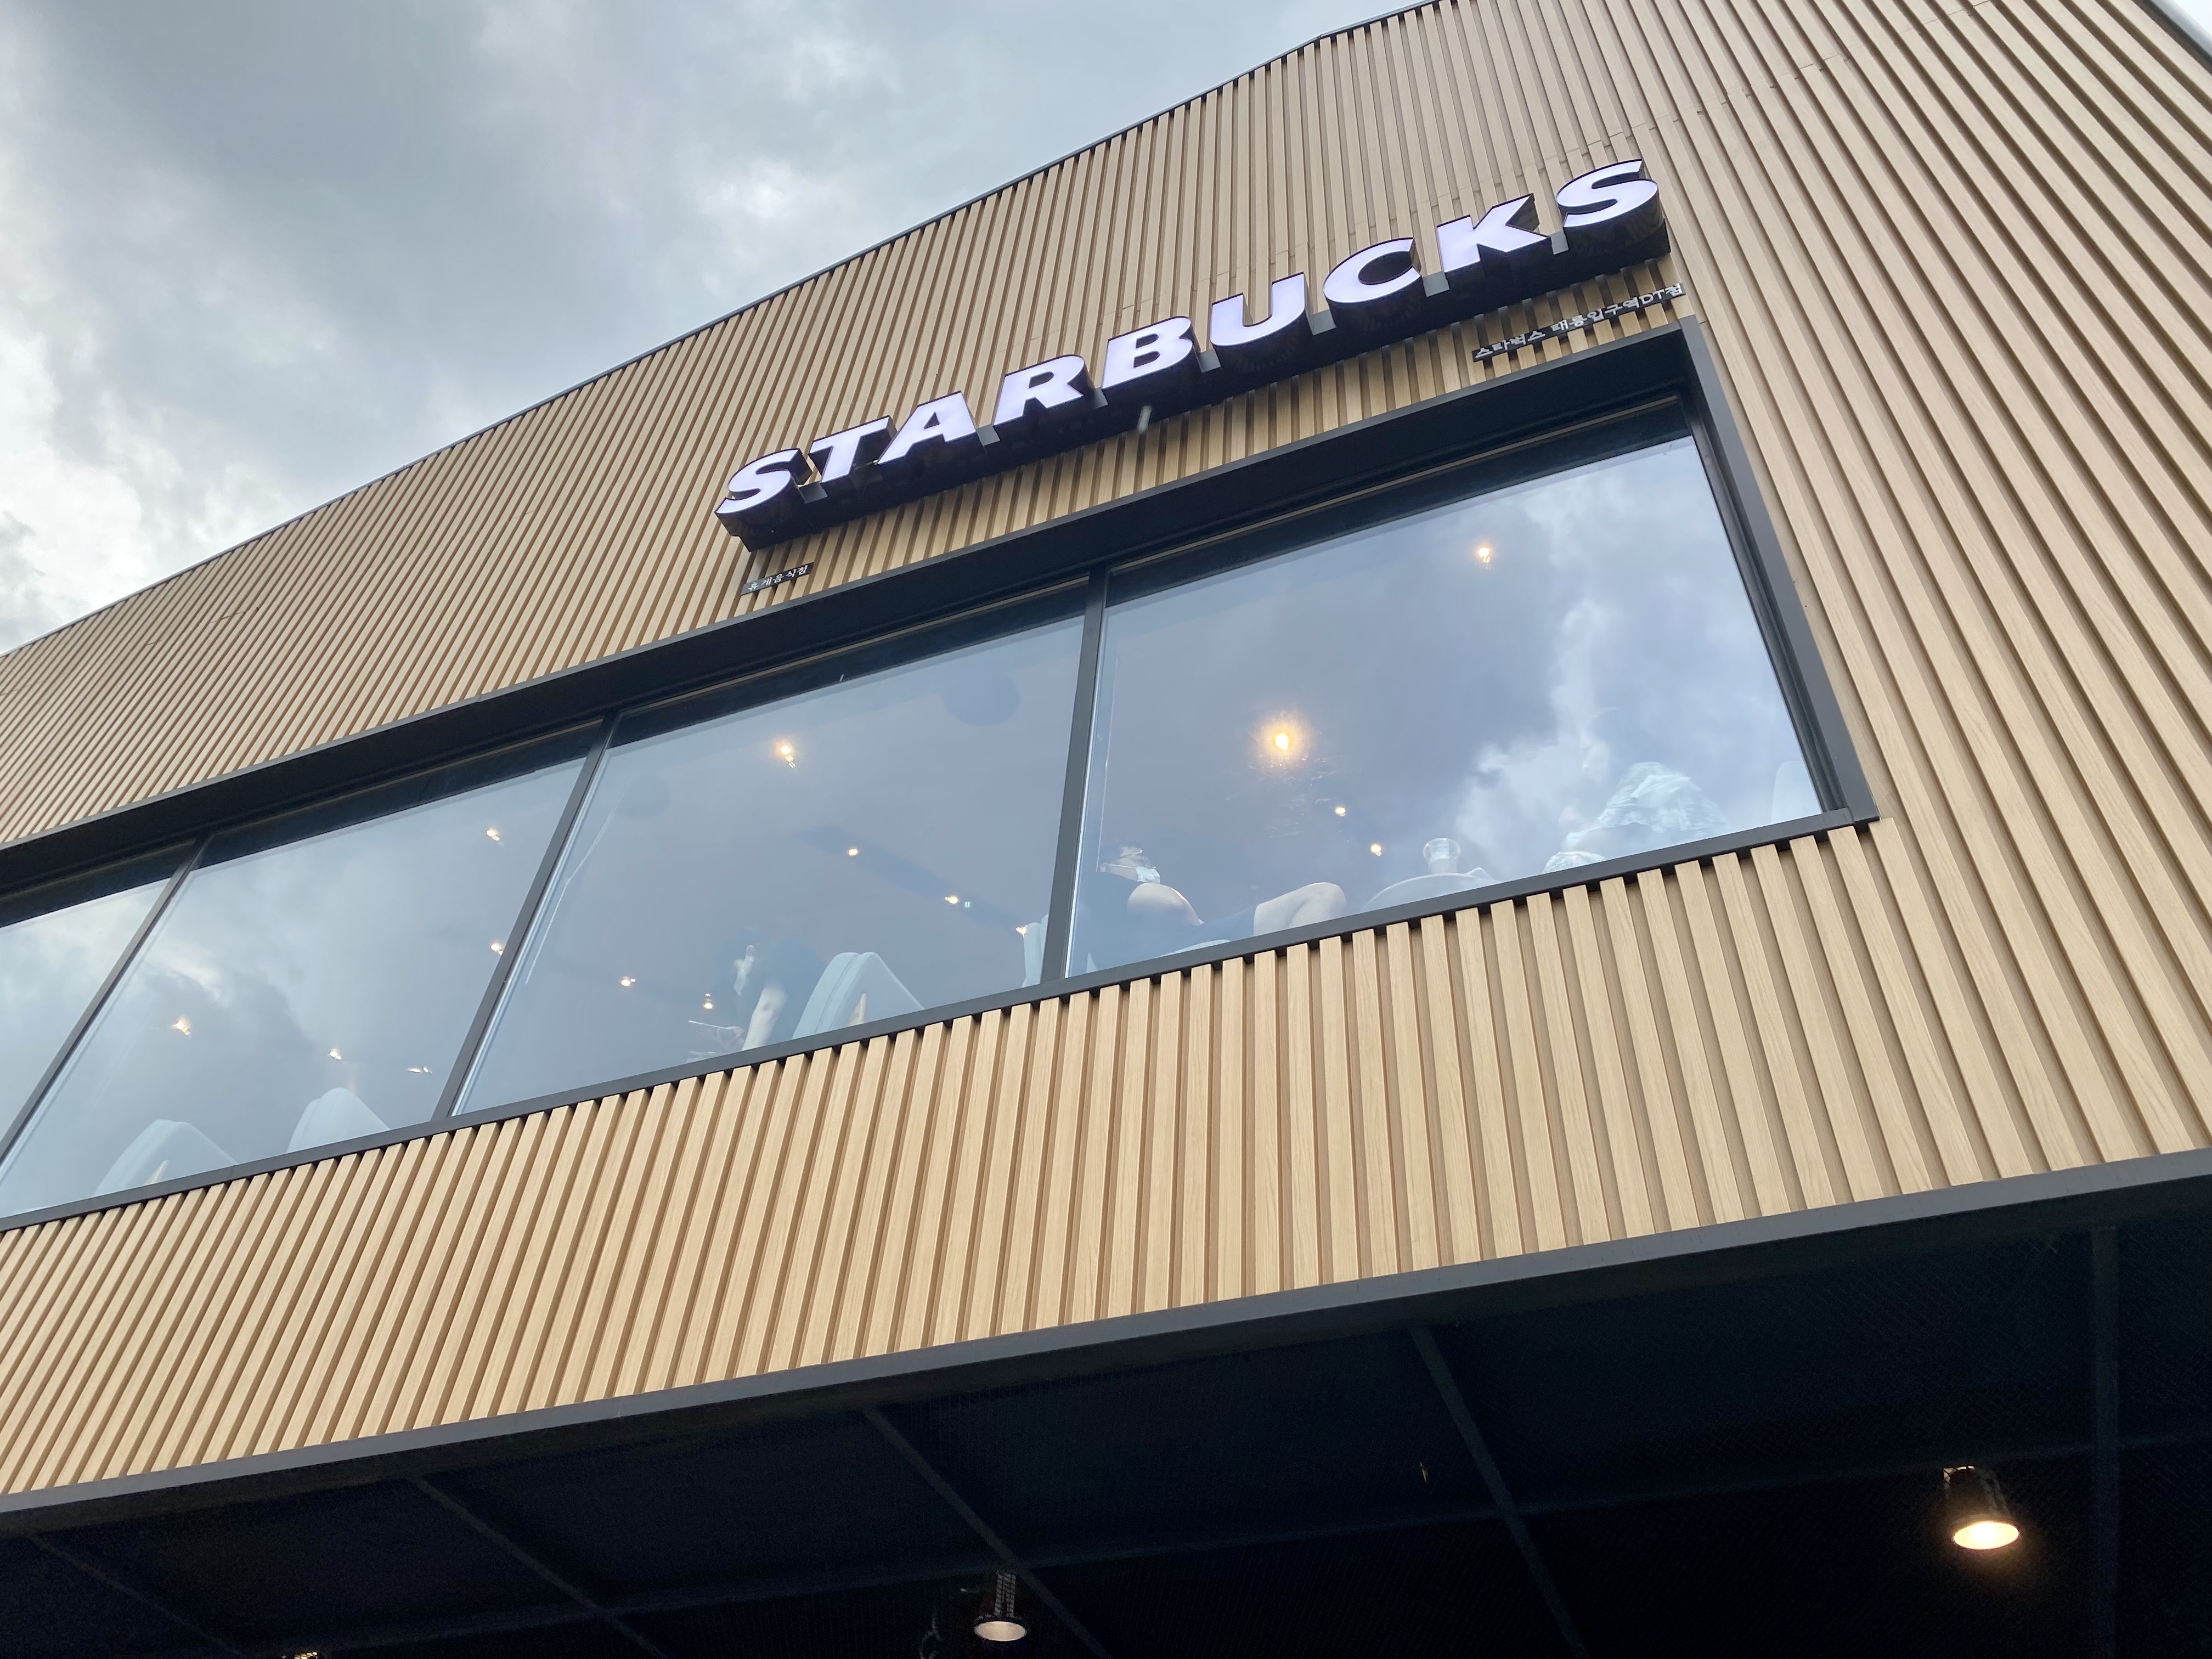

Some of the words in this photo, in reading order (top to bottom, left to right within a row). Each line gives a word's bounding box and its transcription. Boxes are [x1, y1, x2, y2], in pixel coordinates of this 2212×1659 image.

[716, 160, 1658, 514] STARBUCKS
[1475, 330, 1546, 358] 스타벅스
[1550, 283, 1683, 332] 태릉입구역DT점
[747, 565, 809, 591] 휴게음식점
